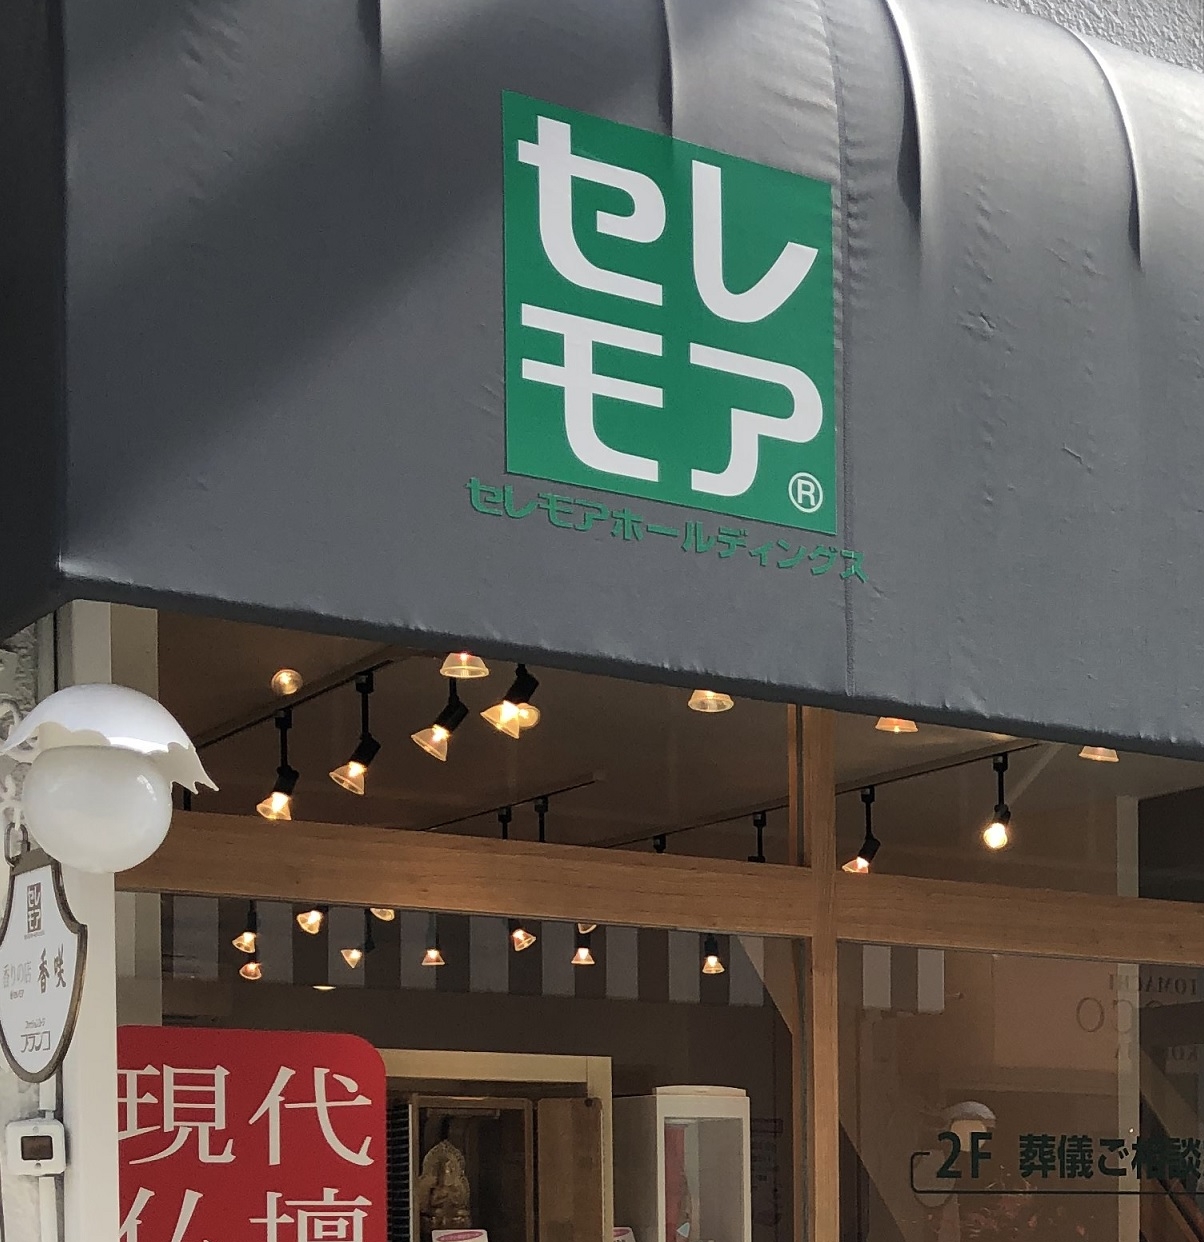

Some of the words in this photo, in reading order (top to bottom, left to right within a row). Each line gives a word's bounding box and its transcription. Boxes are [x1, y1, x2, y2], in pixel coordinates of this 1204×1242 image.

[517, 115, 818, 323] セレ
[466, 477, 869, 583] セレモアホールディングス
[38, 943, 67, 994] 香咲
[117, 1064, 375, 1167] 現代
[936, 1131, 993, 1180] 2F
